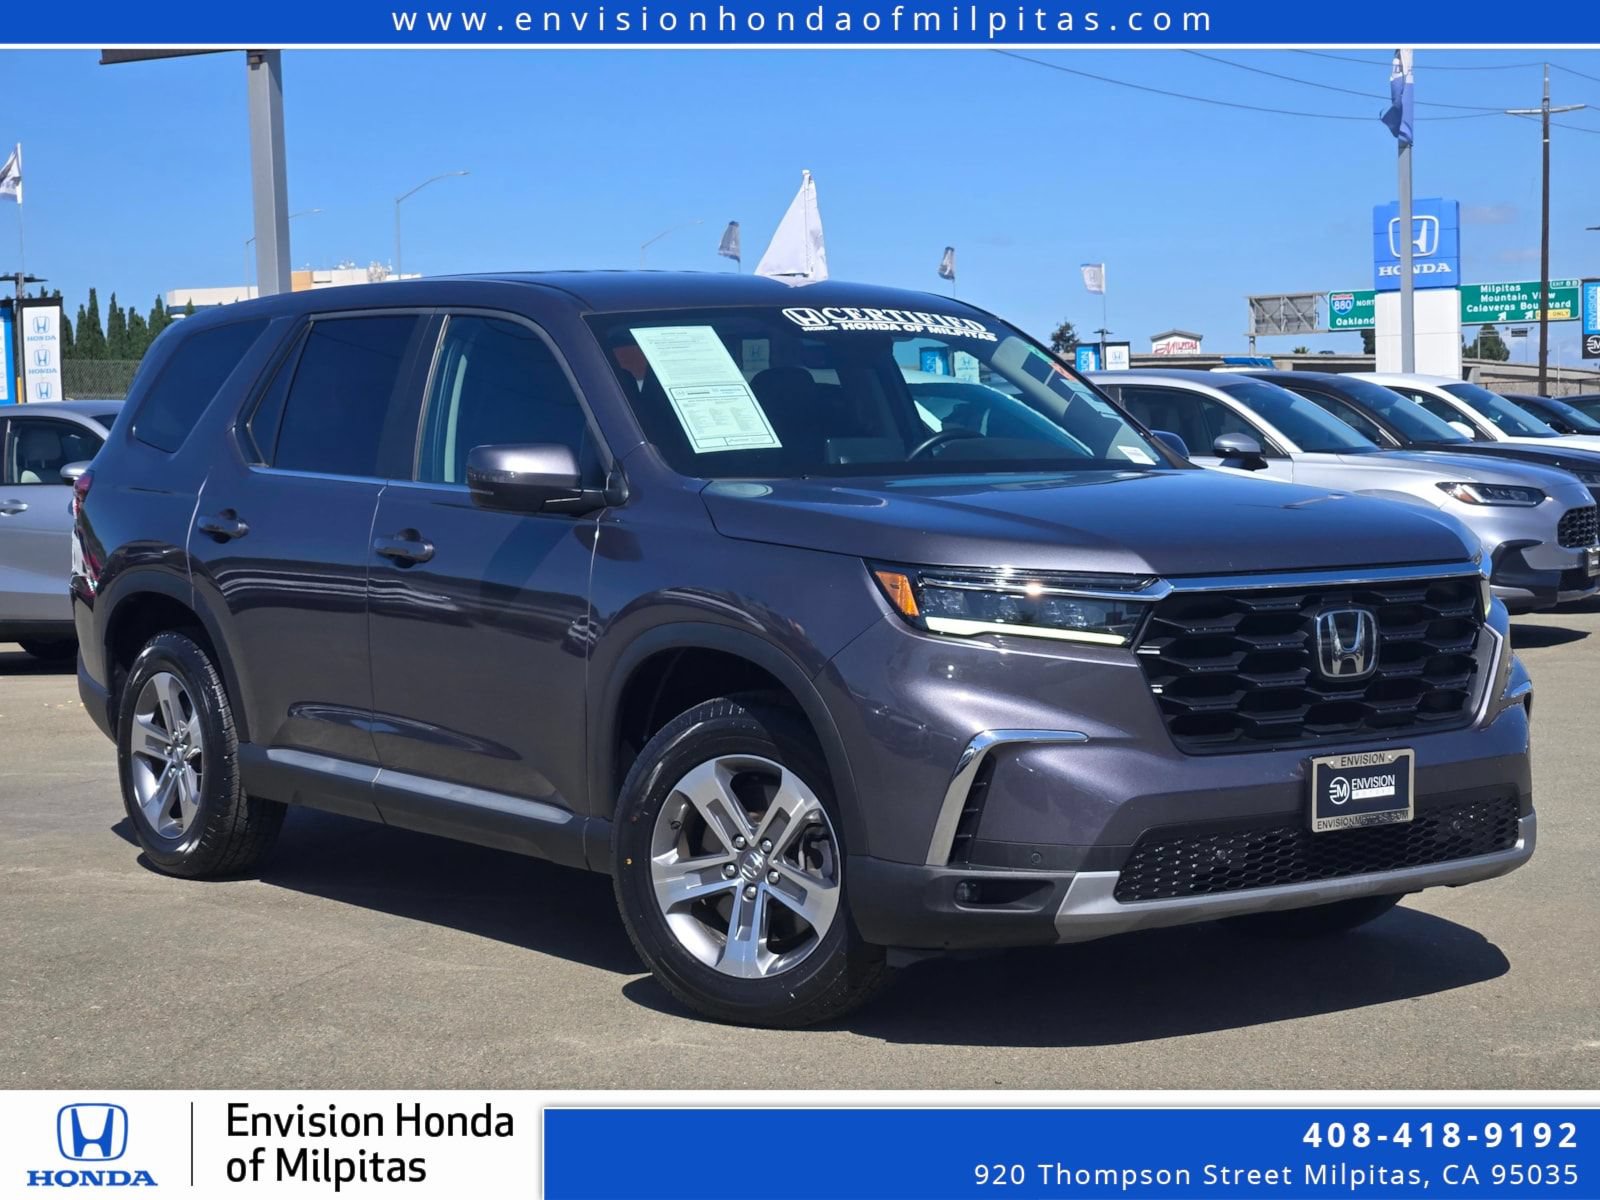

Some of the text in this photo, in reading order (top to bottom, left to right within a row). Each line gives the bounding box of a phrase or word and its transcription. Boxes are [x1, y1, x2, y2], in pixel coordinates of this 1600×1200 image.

[1480, 284, 1521, 294] Milpitas
[1480, 291, 1556, 303] Mountain Viw
[1334, 301, 1352, 310] 880
[1466, 300, 1571, 312] Calaveras Bouvard
[822, 307, 987, 333] CERTIFIED
[1336, 317, 1375, 326] Oakland
[841, 323, 998, 341] HONDA OF MILPITAS
[1340, 753, 1385, 767] ENVISION
[1351, 774, 1395, 790] ENVISION
